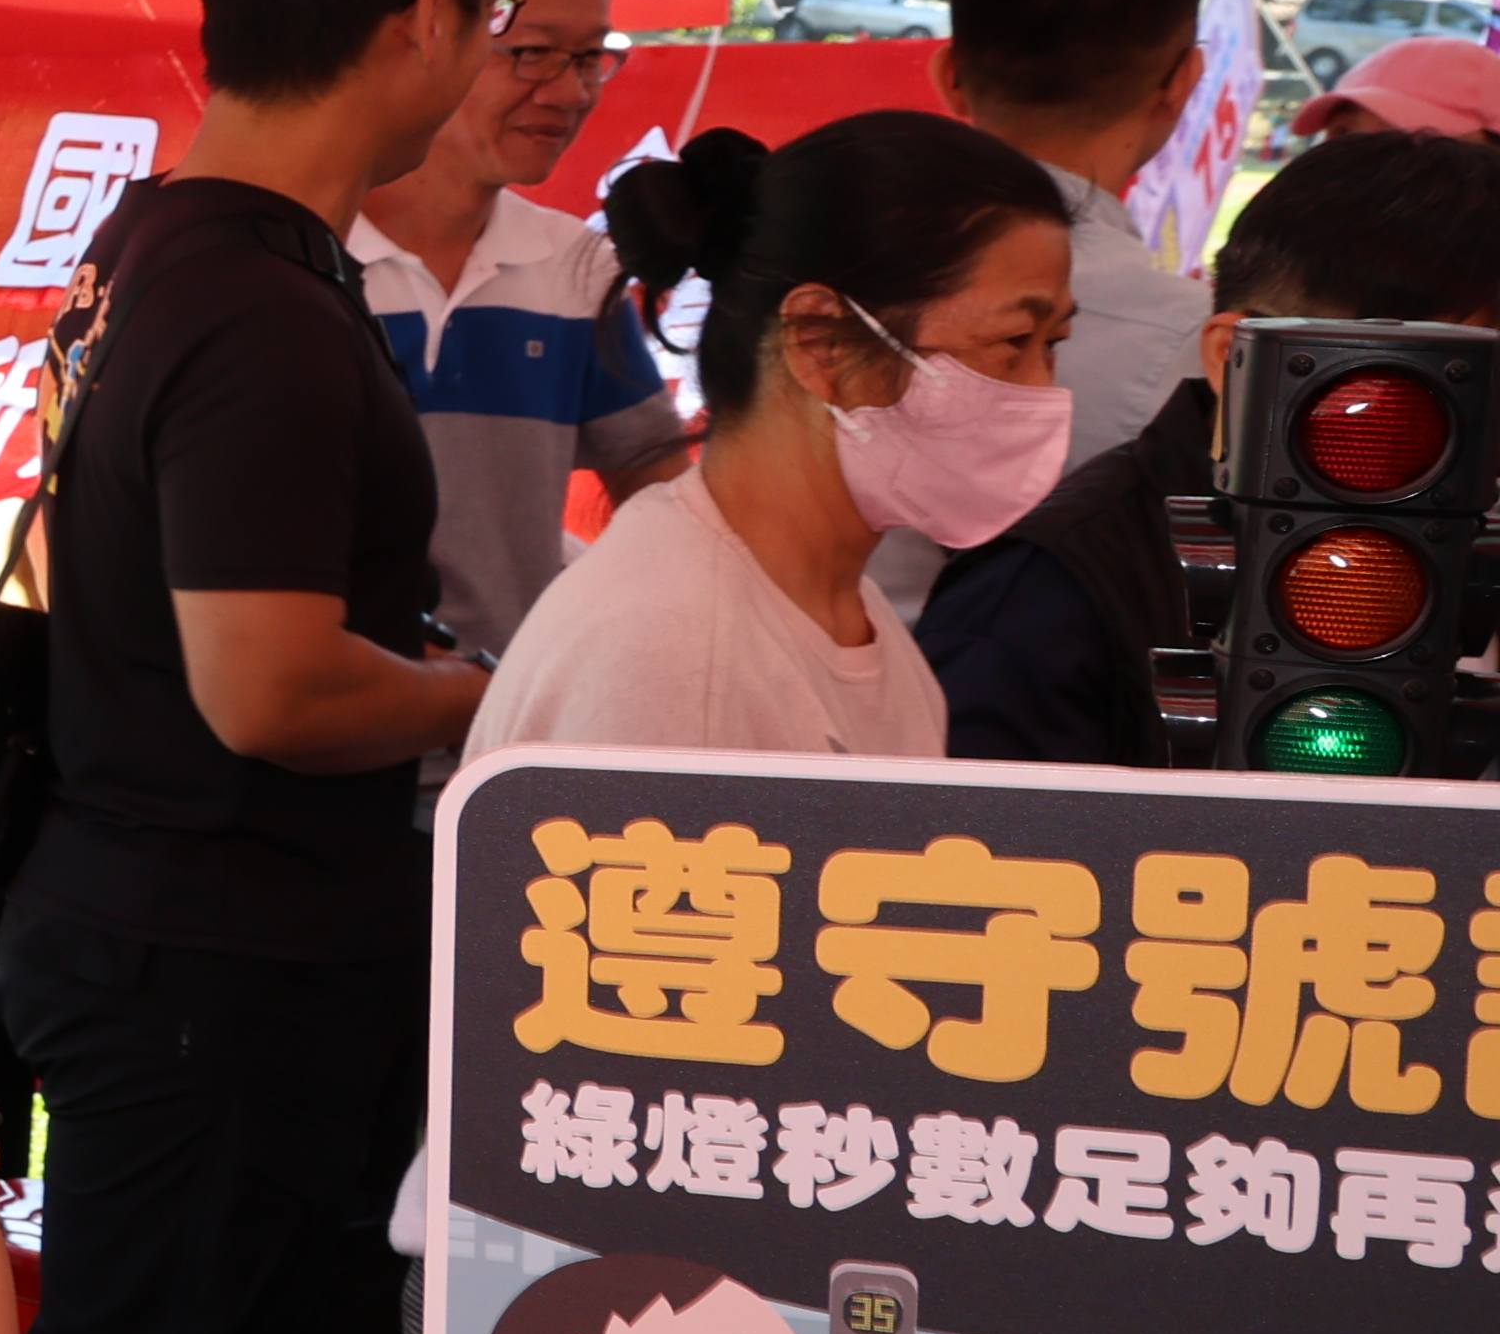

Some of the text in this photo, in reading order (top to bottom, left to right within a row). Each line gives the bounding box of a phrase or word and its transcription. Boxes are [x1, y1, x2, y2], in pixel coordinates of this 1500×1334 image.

[512, 815, 1500, 1121] 遵守號
[519, 1079, 1500, 1277] 綠燈秒數足夠再
